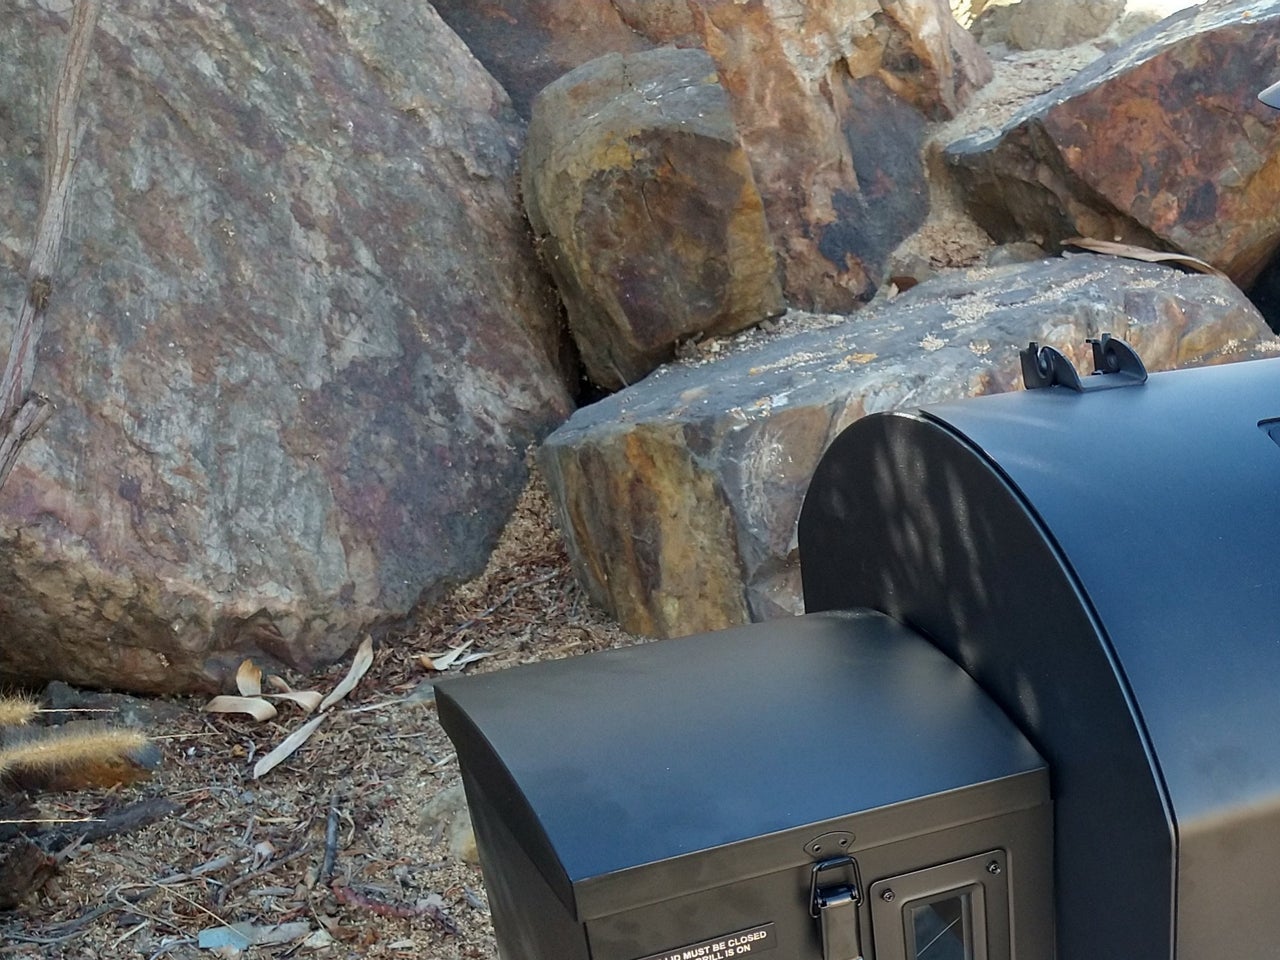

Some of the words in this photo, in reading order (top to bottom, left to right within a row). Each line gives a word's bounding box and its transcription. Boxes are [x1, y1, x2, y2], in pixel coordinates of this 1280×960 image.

[683, 945, 710, 960] MUST
[712, 941, 726, 952] BE
[728, 930, 767, 948] CLOSED
[725, 948, 735, 957] IS
[736, 944, 751, 955] ON
